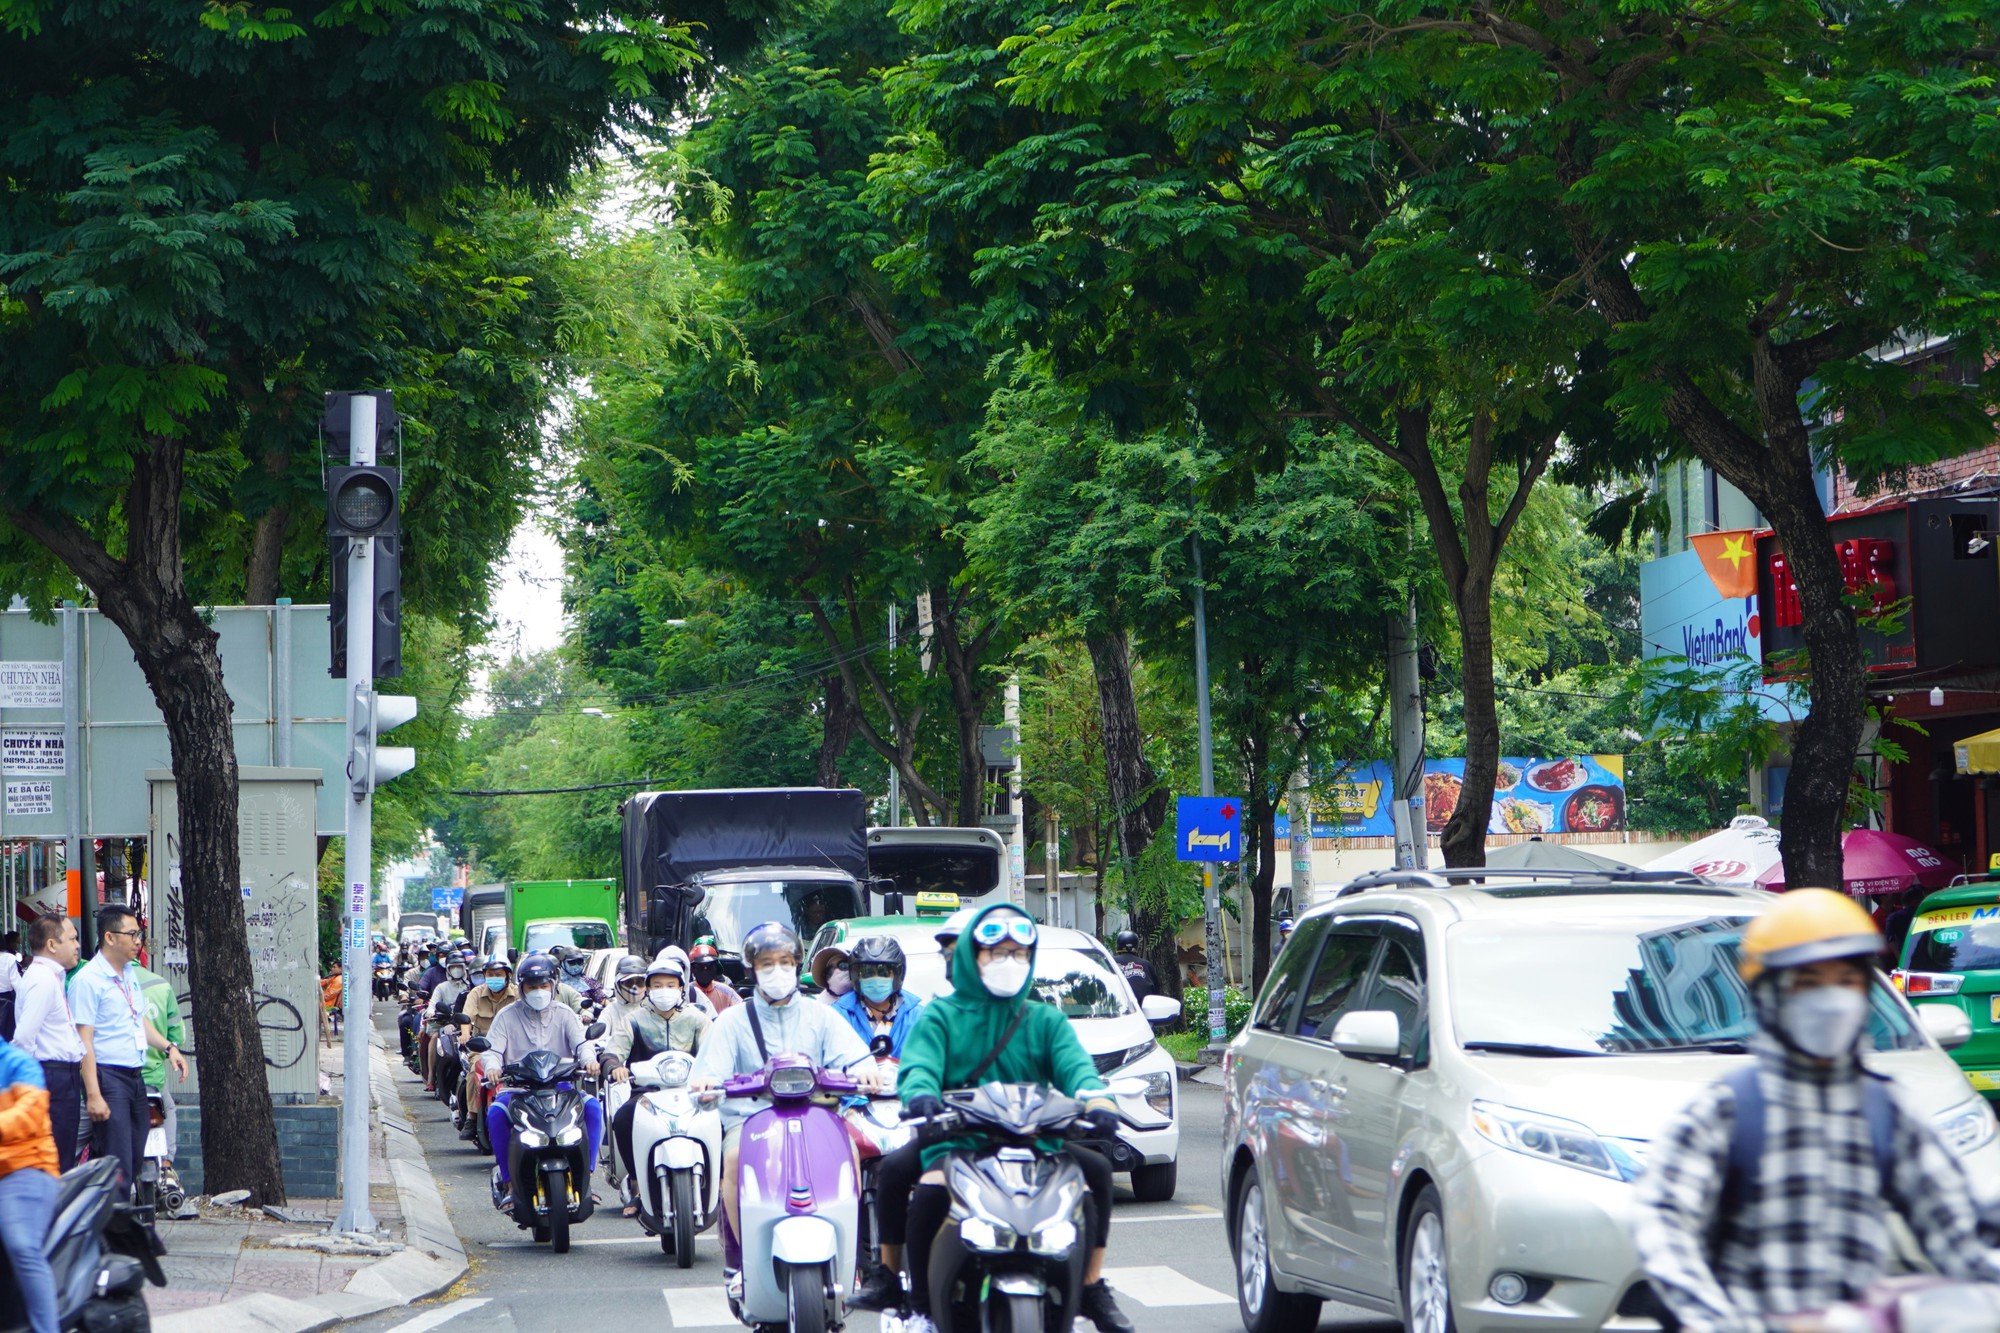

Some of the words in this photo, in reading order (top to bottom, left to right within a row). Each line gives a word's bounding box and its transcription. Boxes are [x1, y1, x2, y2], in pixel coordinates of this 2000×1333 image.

[1682, 613, 1748, 667] VietinBank
[41, 669, 61, 684] NHÀ
[4, 735, 41, 748] CHUYỂN
[45, 737, 64, 748] NHÀ
[1928, 912, 1947, 924] ĐÈN
[1950, 912, 1968, 921] LED
